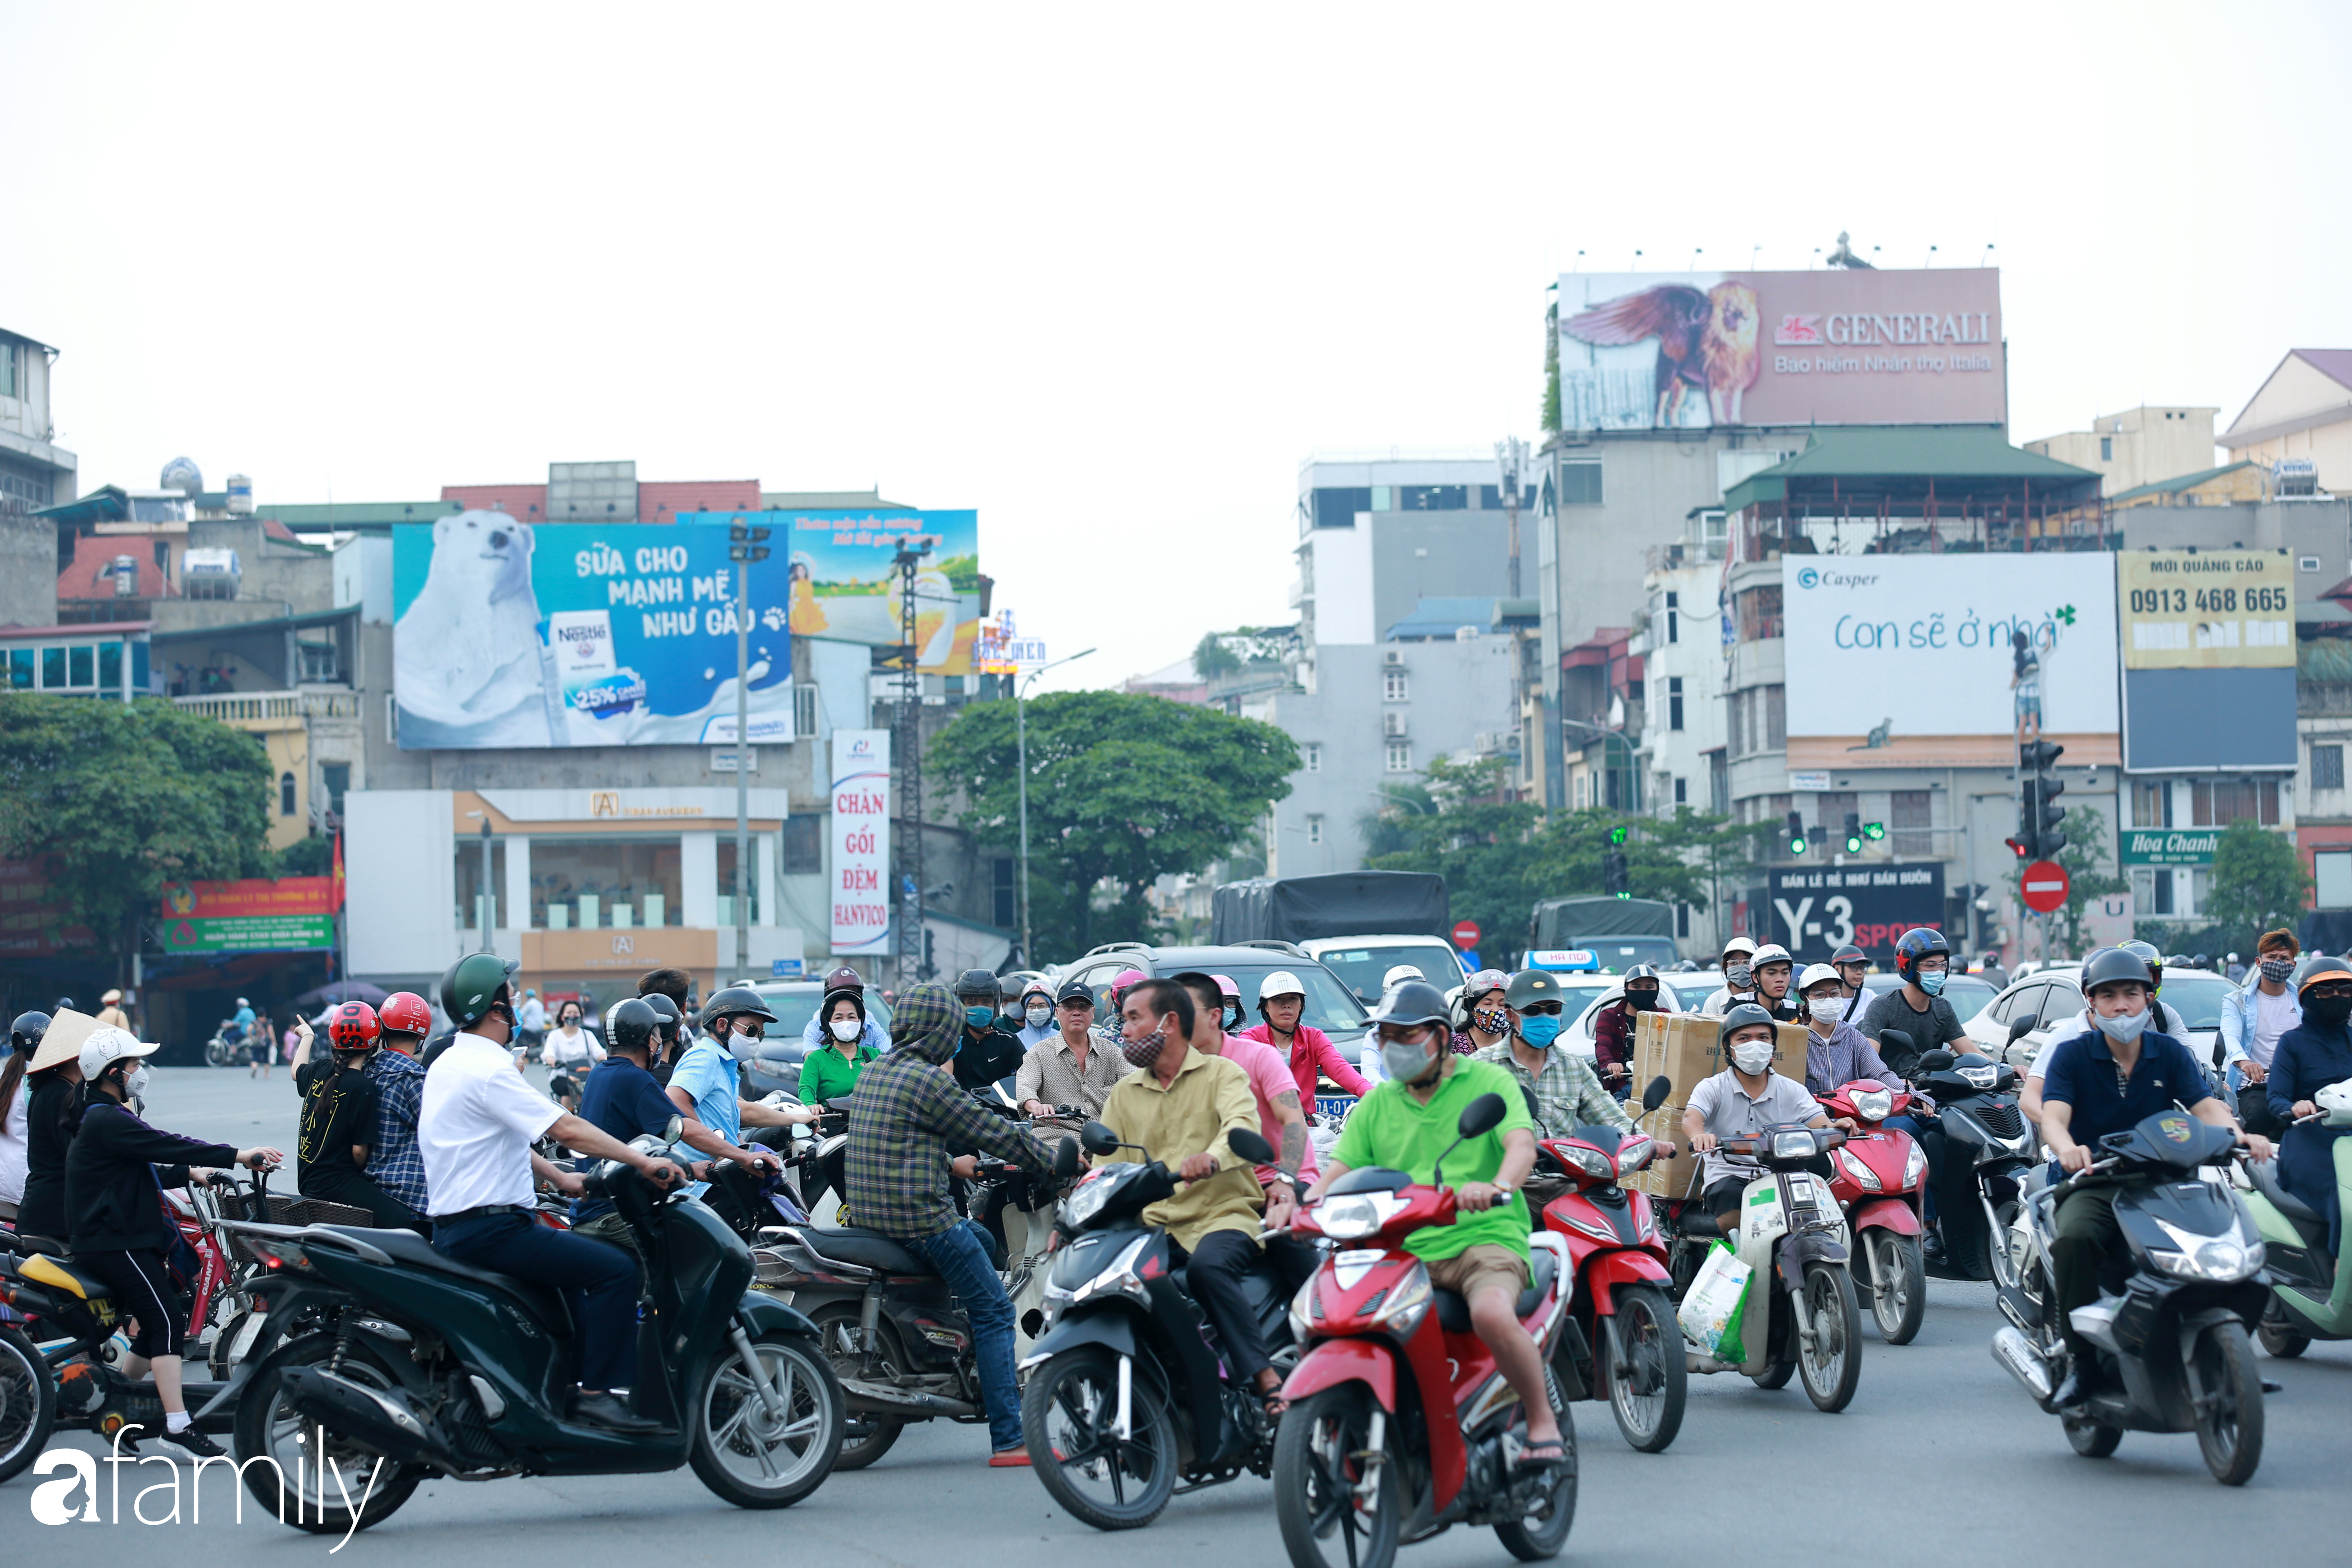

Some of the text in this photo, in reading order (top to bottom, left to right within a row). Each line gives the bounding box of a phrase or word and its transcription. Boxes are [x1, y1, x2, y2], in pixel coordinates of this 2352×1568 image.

[1825, 313, 1991, 345] GENERALI
[1950, 354, 1991, 372] Italia
[575, 541, 688, 577] SỮA CHO
[608, 569, 731, 609] MẠNH MẼ
[1822, 571, 1880, 588] Casper
[2131, 587, 2287, 613] 0913 468 665
[642, 606, 697, 639] NHƯ
[1835, 615, 1899, 649] Con
[1909, 613, 1947, 648] sẽ
[1958, 608, 1980, 648] ở
[577, 685, 618, 709] 25%
[837, 787, 884, 814] CHĂN
[846, 824, 875, 854] GỐI
[2131, 833, 2218, 853] Hoa Chanh
[843, 863, 878, 896] ĐỆM
[1781, 873, 1805, 889] BÁN
[1846, 871, 1871, 886] NHƯ
[1873, 870, 1898, 886] BÁN
[1900, 869, 1932, 885] BUÔN
[835, 904, 885, 926] HANVICO
[1773, 895, 1942, 952] Y-3 SPO
[202, 1261, 214, 1296] GIANT
